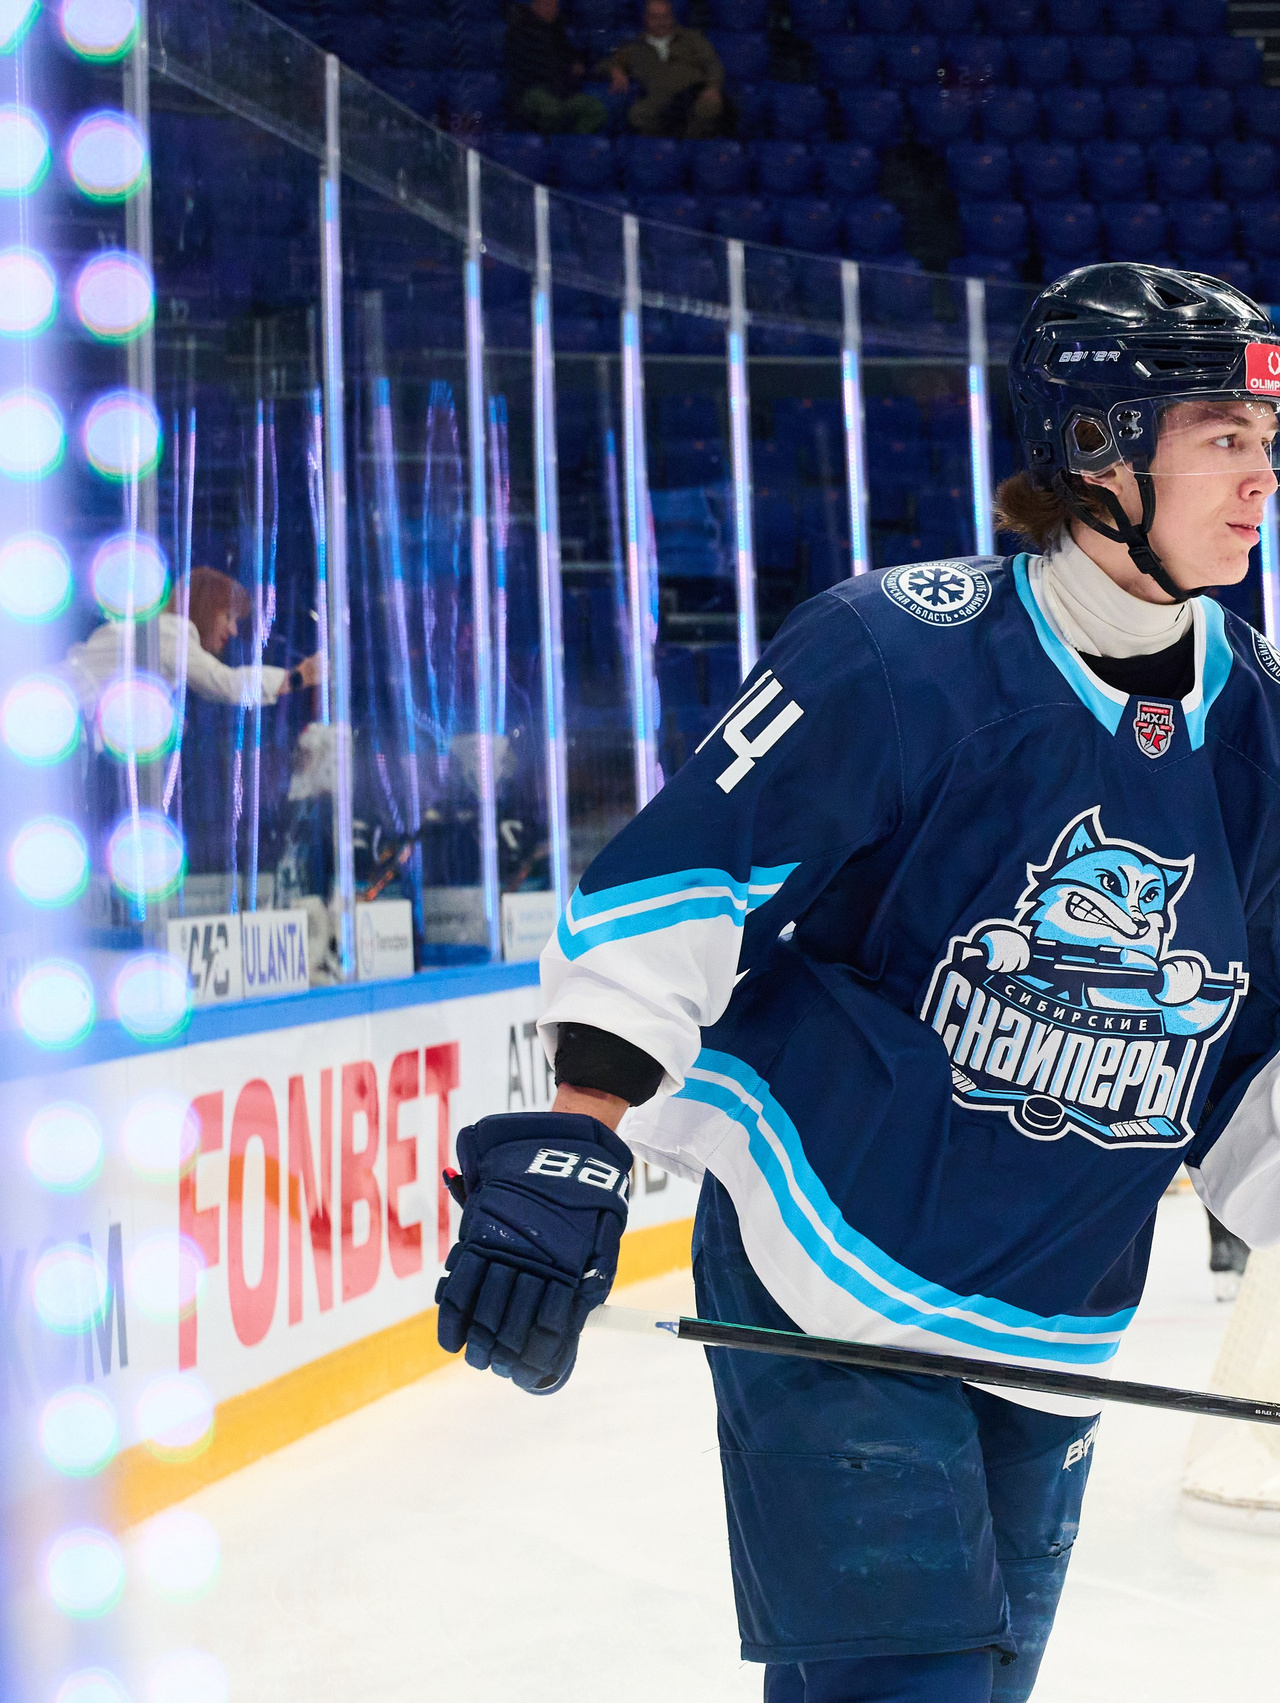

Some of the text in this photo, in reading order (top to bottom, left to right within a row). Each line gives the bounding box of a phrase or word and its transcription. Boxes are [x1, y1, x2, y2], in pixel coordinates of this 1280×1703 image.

[909, 603, 953, 623] ОБЛАСТЬ
[958, 592, 986, 617] СИБИРЬ
[1140, 712, 1169, 725] МХЛ
[1004, 984, 1148, 1031] СИБИРСКИЕ
[931, 970, 1197, 1118] СНАЙПЕРЫ
[178, 1041, 460, 1372] FONBET
